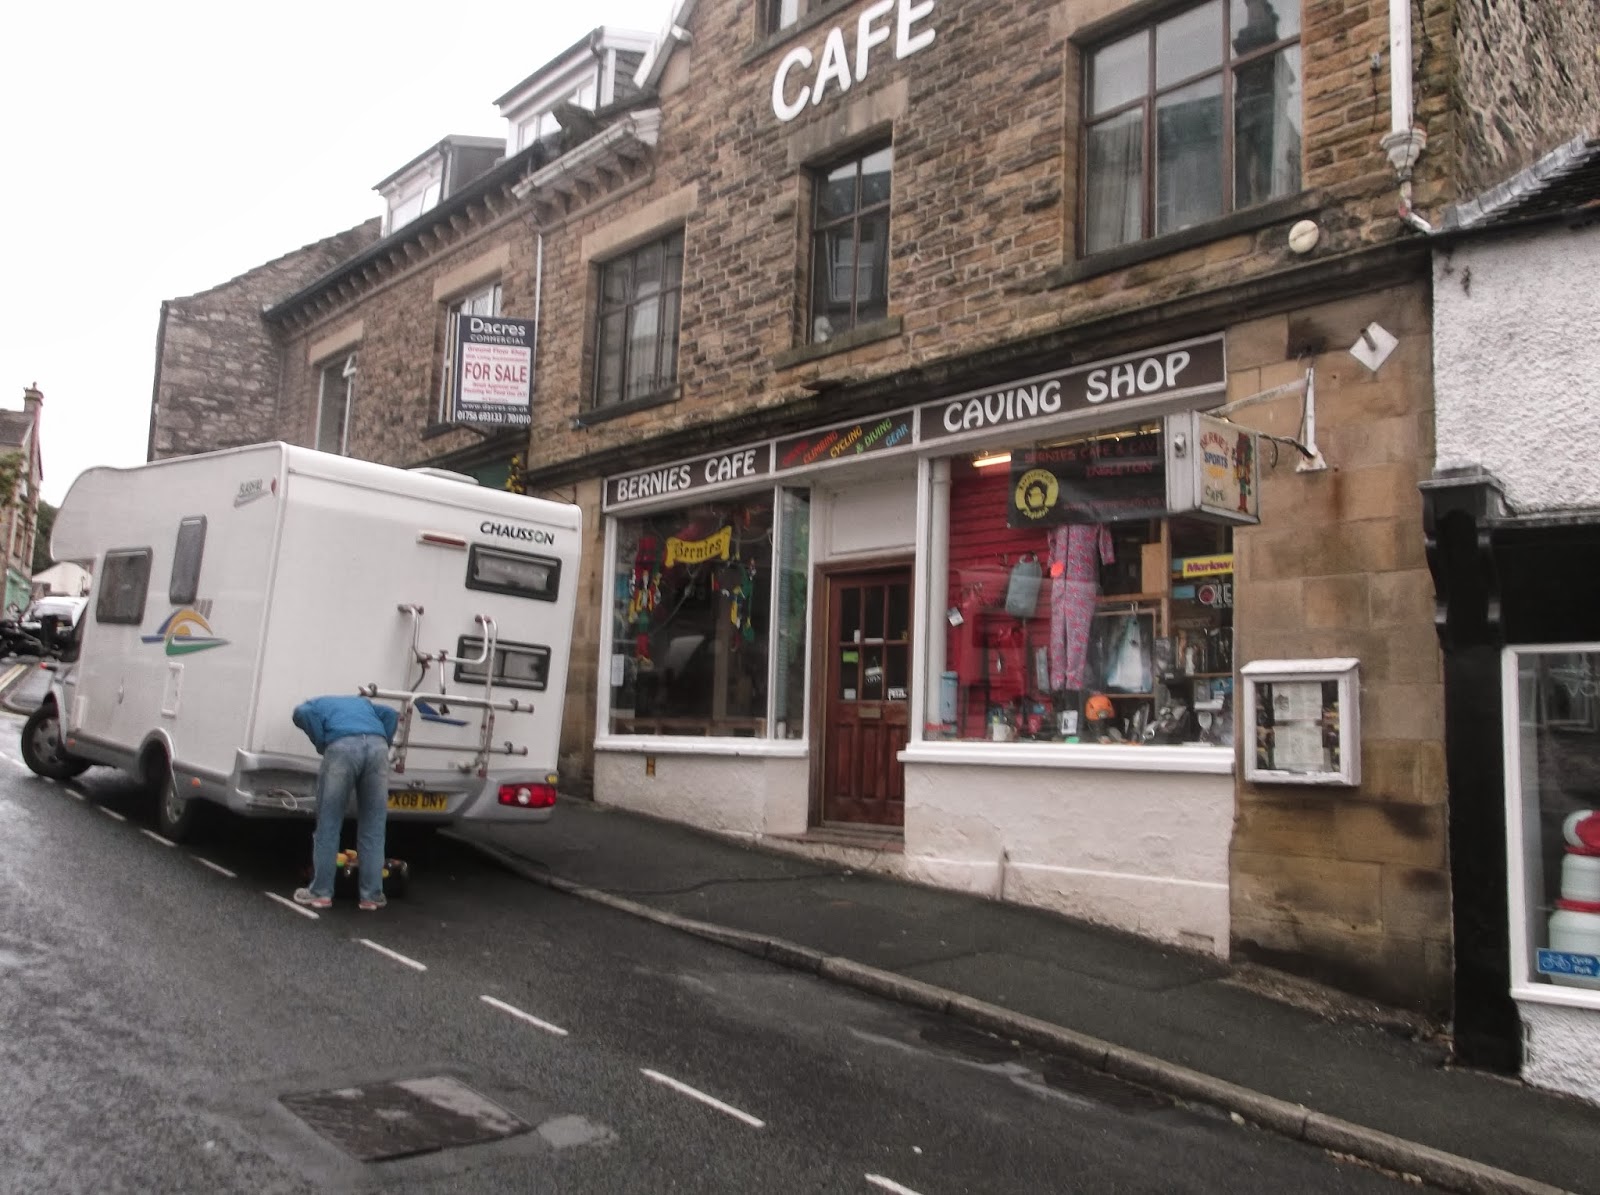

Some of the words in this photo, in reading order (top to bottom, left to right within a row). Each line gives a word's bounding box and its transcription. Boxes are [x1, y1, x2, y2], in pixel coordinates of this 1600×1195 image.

[772, 0, 936, 122] CAFE
[469, 333, 525, 345] COMMERCIAL
[470, 317, 526, 337] Dacres
[465, 362, 491, 380] FOR
[495, 364, 528, 384] SALE
[943, 380, 1061, 432] CAVING
[1086, 351, 1190, 404] SHOP
[830, 425, 863, 458] CYCLING
[864, 417, 893, 448] DIVING
[886, 423, 909, 447] GEAR
[803, 430, 838, 464] CLIMBING
[1204, 452, 1229, 470] SPORTS
[617, 464, 691, 501] BERNIES
[705, 449, 756, 484] CAFE
[480, 521, 555, 546] CHAUSSON
[674, 539, 722, 560] Bernies
[1187, 560, 1230, 572] Marlow
